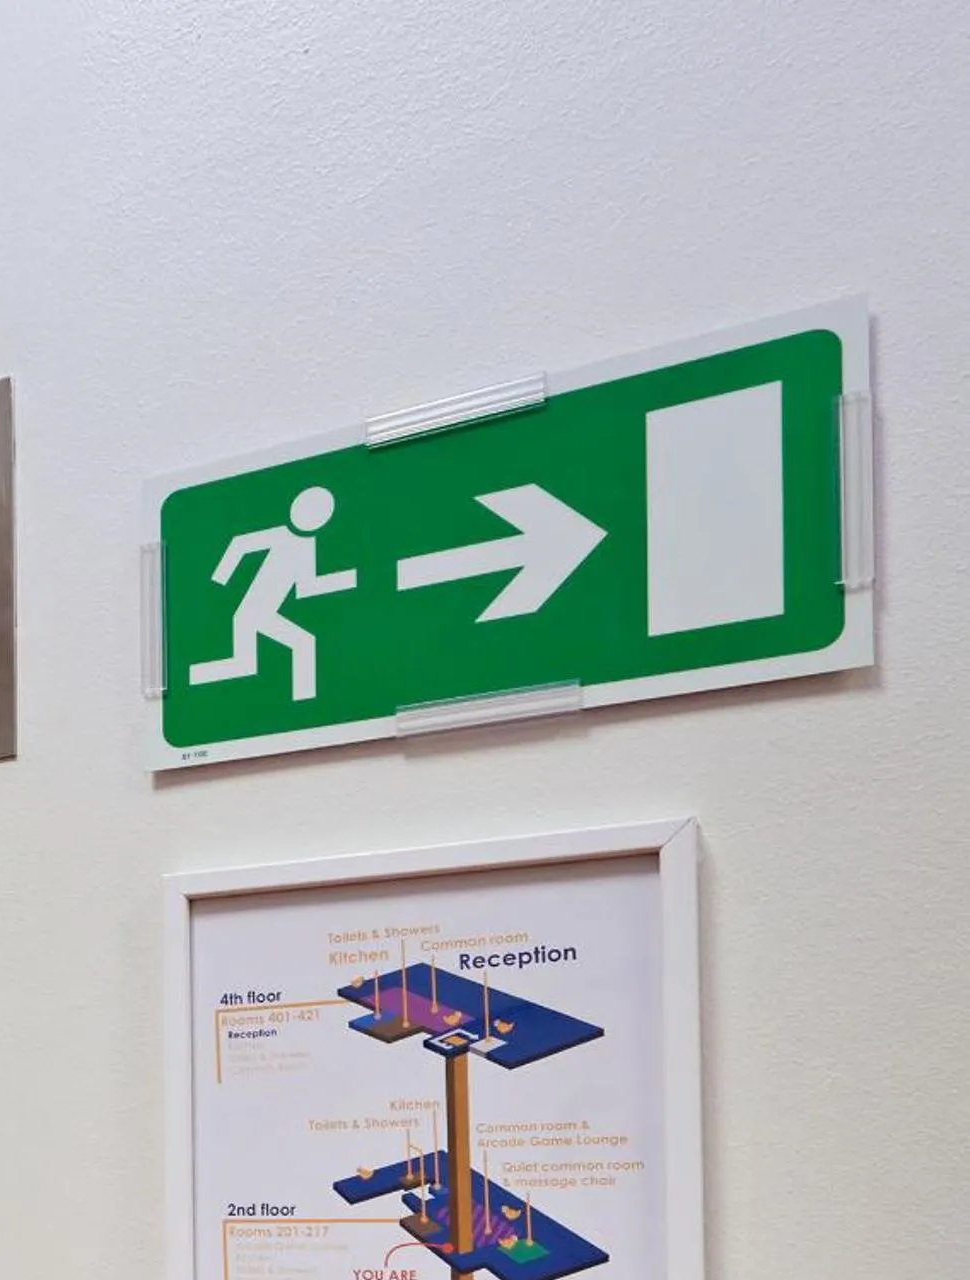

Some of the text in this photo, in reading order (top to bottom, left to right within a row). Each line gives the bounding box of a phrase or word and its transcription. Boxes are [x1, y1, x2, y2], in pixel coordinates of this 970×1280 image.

[371, 929, 381, 939] &
[384, 924, 440, 938] Showers
[421, 932, 529, 951] Common room
[329, 950, 389, 965] Kitchen
[460, 946, 577, 971] Reception
[220, 991, 282, 1006] 4th floor
[228, 1029, 277, 1040] Reception
[390, 1098, 440, 1111] Kitchen
[227, 1203, 297, 1217] 2nd floor
